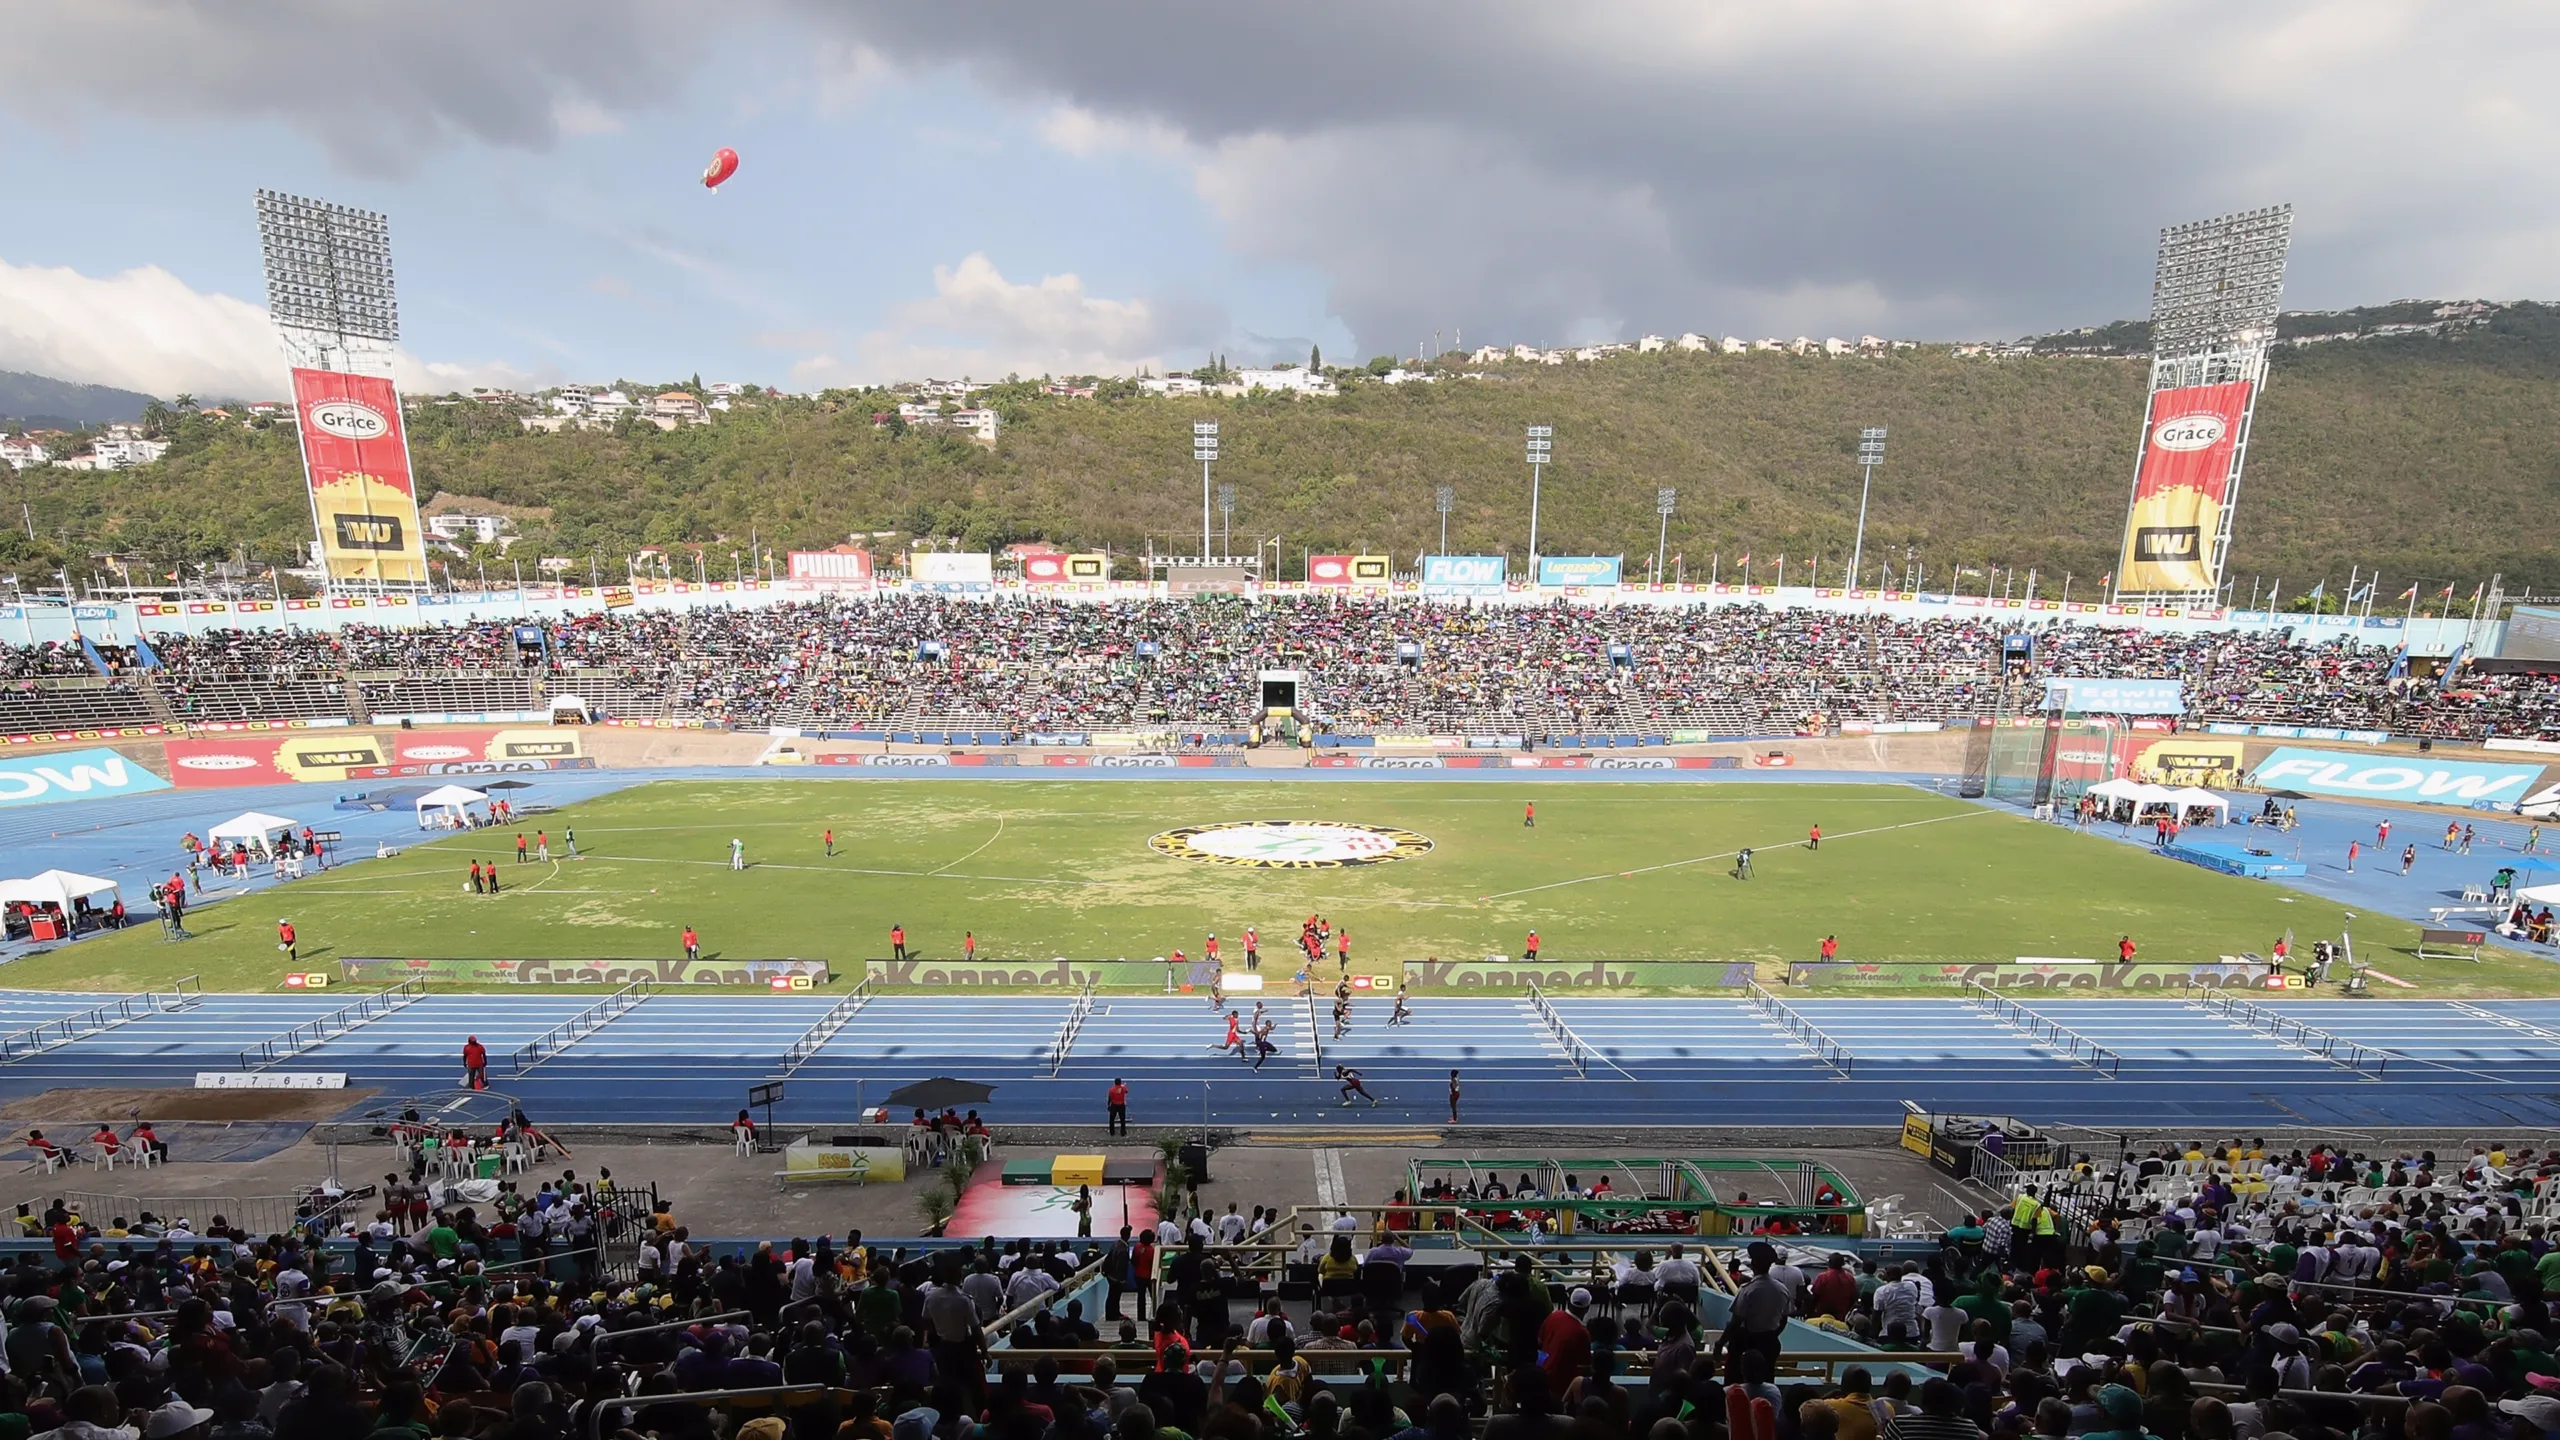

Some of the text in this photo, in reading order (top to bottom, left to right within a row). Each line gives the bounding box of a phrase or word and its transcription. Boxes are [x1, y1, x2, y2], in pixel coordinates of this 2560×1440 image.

[322, 412, 377, 430] Grace
[2163, 427, 2217, 442] Grace
[347, 520, 392, 543] WU
[2150, 534, 2194, 554] WU
[793, 553, 859, 578] PUMA
[1428, 560, 1499, 582] FLOW
[1546, 560, 1602, 574] Lucozade
[75, 607, 108, 618] FLOW
[2233, 613, 2261, 622] FLOW
[2277, 614, 2306, 624] FLOW
[2322, 616, 2352, 626] FLOW
[2081, 686, 2176, 698] Edwin
[2089, 698, 2171, 709] Allen
[523, 743, 562, 754] WU
[316, 752, 364, 764] WU
[874, 755, 939, 767] Grace
[1102, 756, 1166, 767] Grace
[1370, 757, 1434, 768] Grace
[1600, 758, 1664, 769] Grace
[2176, 757, 2222, 767] WU
[441, 760, 534, 774] Grace
[2256, 759, 2529, 798] FLOW
[1833, 972, 1903, 983] GraceKennedy
[218, 1076, 323, 1085] 8 7 6 5
[818, 1153, 851, 1168] ISSA
